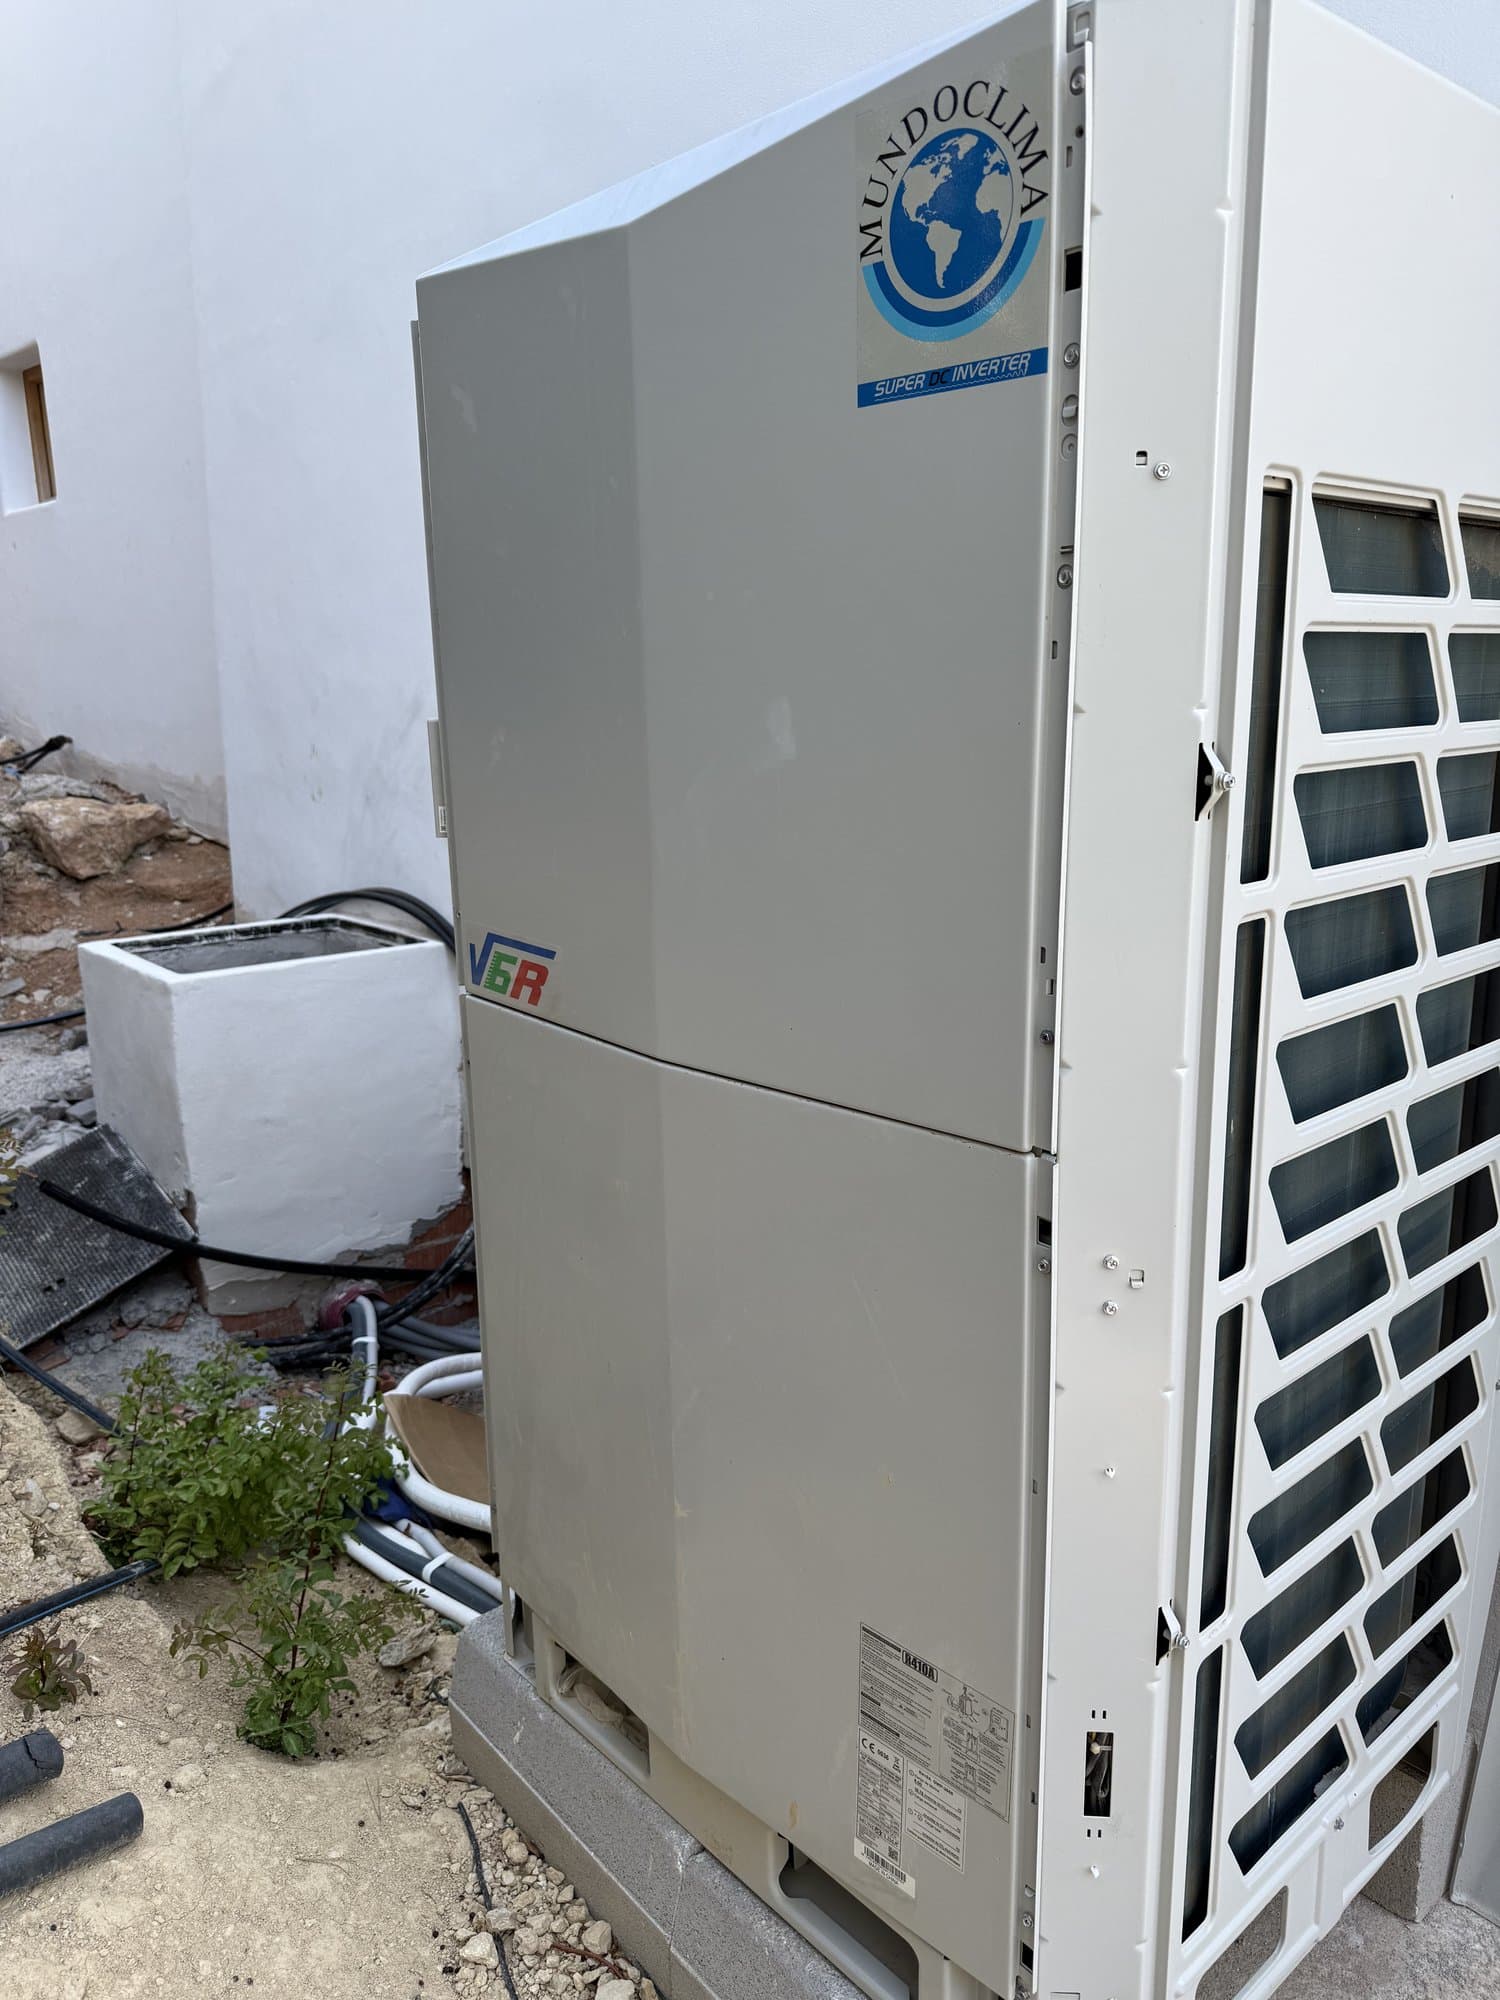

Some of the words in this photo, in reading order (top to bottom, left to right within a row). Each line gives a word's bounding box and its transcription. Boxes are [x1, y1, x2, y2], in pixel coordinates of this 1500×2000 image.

[859, 80, 1049, 263] MUNDOCLIMA
[874, 373, 926, 397] SUPER
[928, 369, 951, 386] DC
[952, 352, 1032, 382] INVERTER
[905, 1651, 936, 1681] R410A
